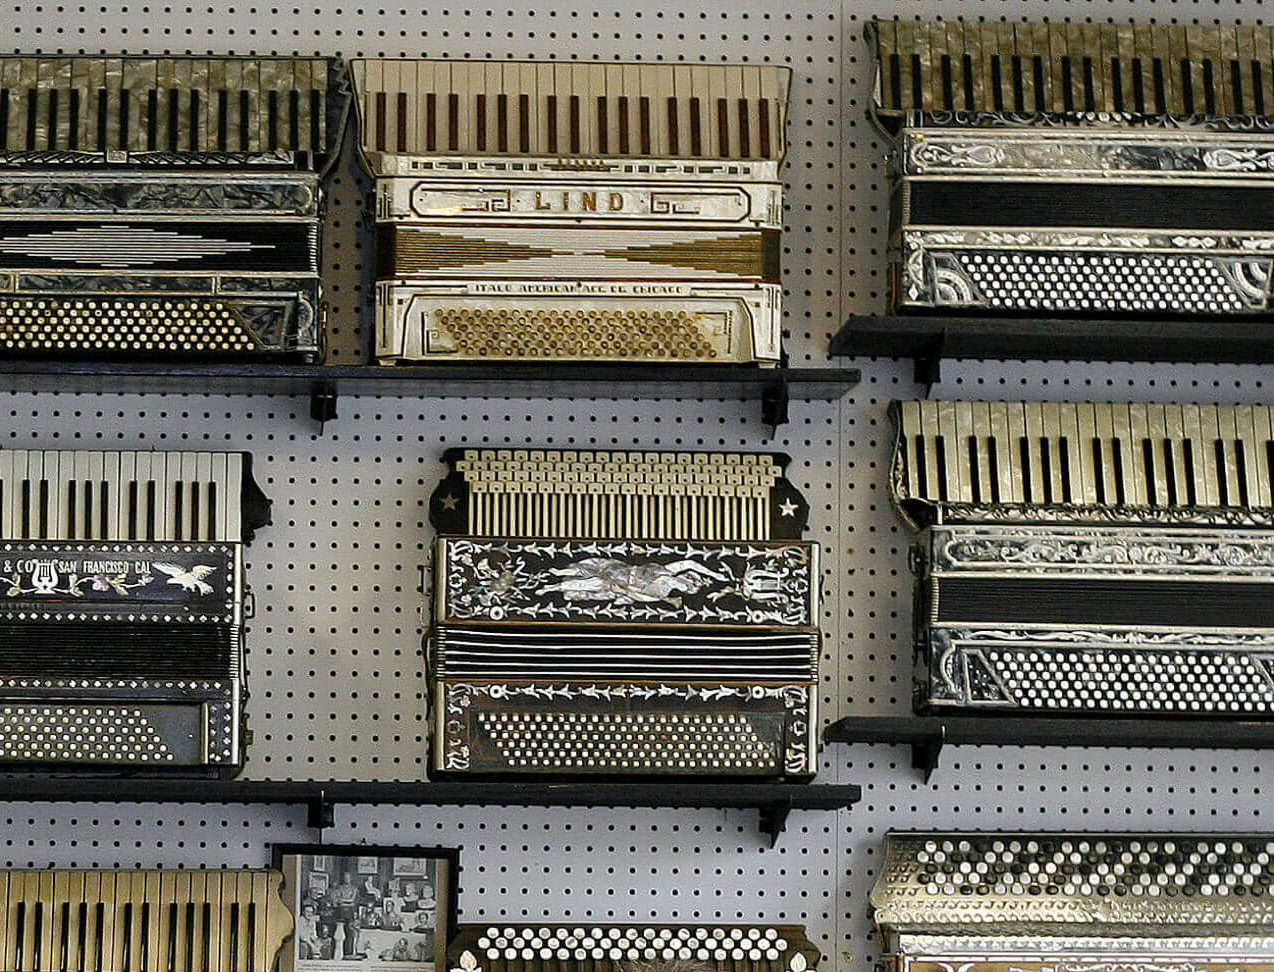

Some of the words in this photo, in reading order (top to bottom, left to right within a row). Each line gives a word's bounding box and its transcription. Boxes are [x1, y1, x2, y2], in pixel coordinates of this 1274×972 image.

[535, 191, 624, 212] LIND
[3, 560, 13, 573] &
[58, 560, 77, 574] SAN
[82, 560, 130, 574] FRANCISCO
[134, 561, 151, 574] CAL
